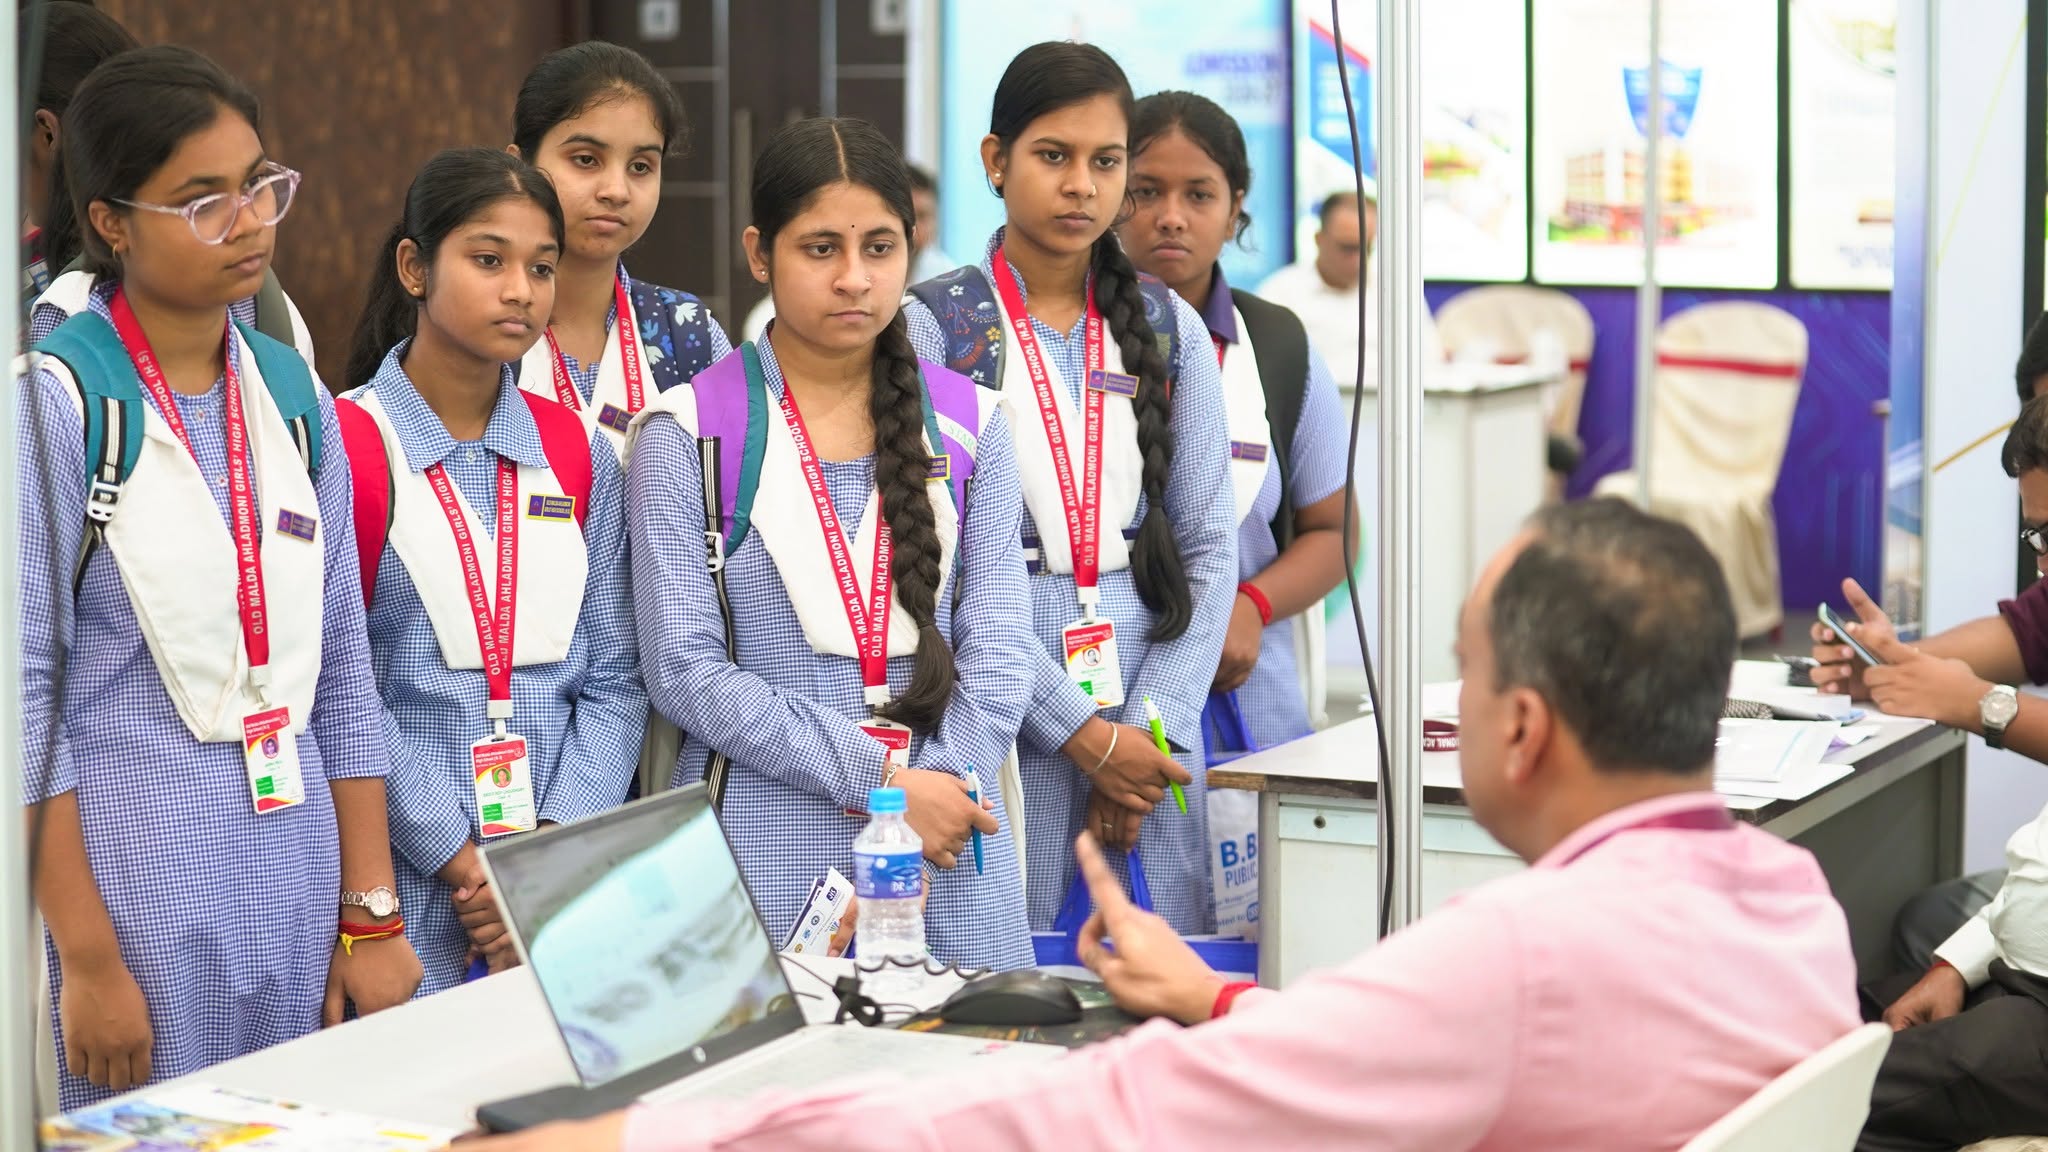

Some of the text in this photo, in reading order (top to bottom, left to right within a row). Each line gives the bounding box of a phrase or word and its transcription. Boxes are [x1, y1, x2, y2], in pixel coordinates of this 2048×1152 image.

[137, 350, 158, 378] (H.S)
[621, 318, 642, 409] HIGH SCHOOL (H.S)
[153, 379, 179, 425] SCHOOL
[228, 376, 240, 420] SCHOOL
[232, 423, 242, 452] HIGH
[789, 421, 813, 463] SCHOOL
[1015, 318, 1081, 545] MALDA AHLADMONI GIRLS' HIGH SCHOOL (H.S)
[1084, 318, 1100, 566] OLD MALDA AHLADMONI GIRLS' HIG HOOL (H.S)
[233, 455, 247, 492] GIRLS'
[434, 478, 453, 504] HIGH
[502, 472, 513, 497] HIGH
[805, 464, 823, 492] HIGH
[236, 495, 255, 563] AHLADMONI
[448, 506, 468, 540] GIRLS'
[502, 500, 513, 533] GIRLS'
[816, 494, 835, 528] GIRLS'
[461, 543, 486, 609] AHLADMONI
[501, 537, 513, 603] AHLADMONI
[828, 531, 857, 595] AHLADMONI
[876, 526, 891, 591] AHLADMONI
[245, 566, 261, 607] MALDA
[252, 610, 264, 635] OLD
[479, 611, 496, 651] MALDA
[499, 606, 511, 644] MALDA
[849, 597, 868, 635] MALDA
[873, 595, 886, 631] MALDA
[488, 653, 501, 676] OLD
[871, 635, 883, 658] OLD
